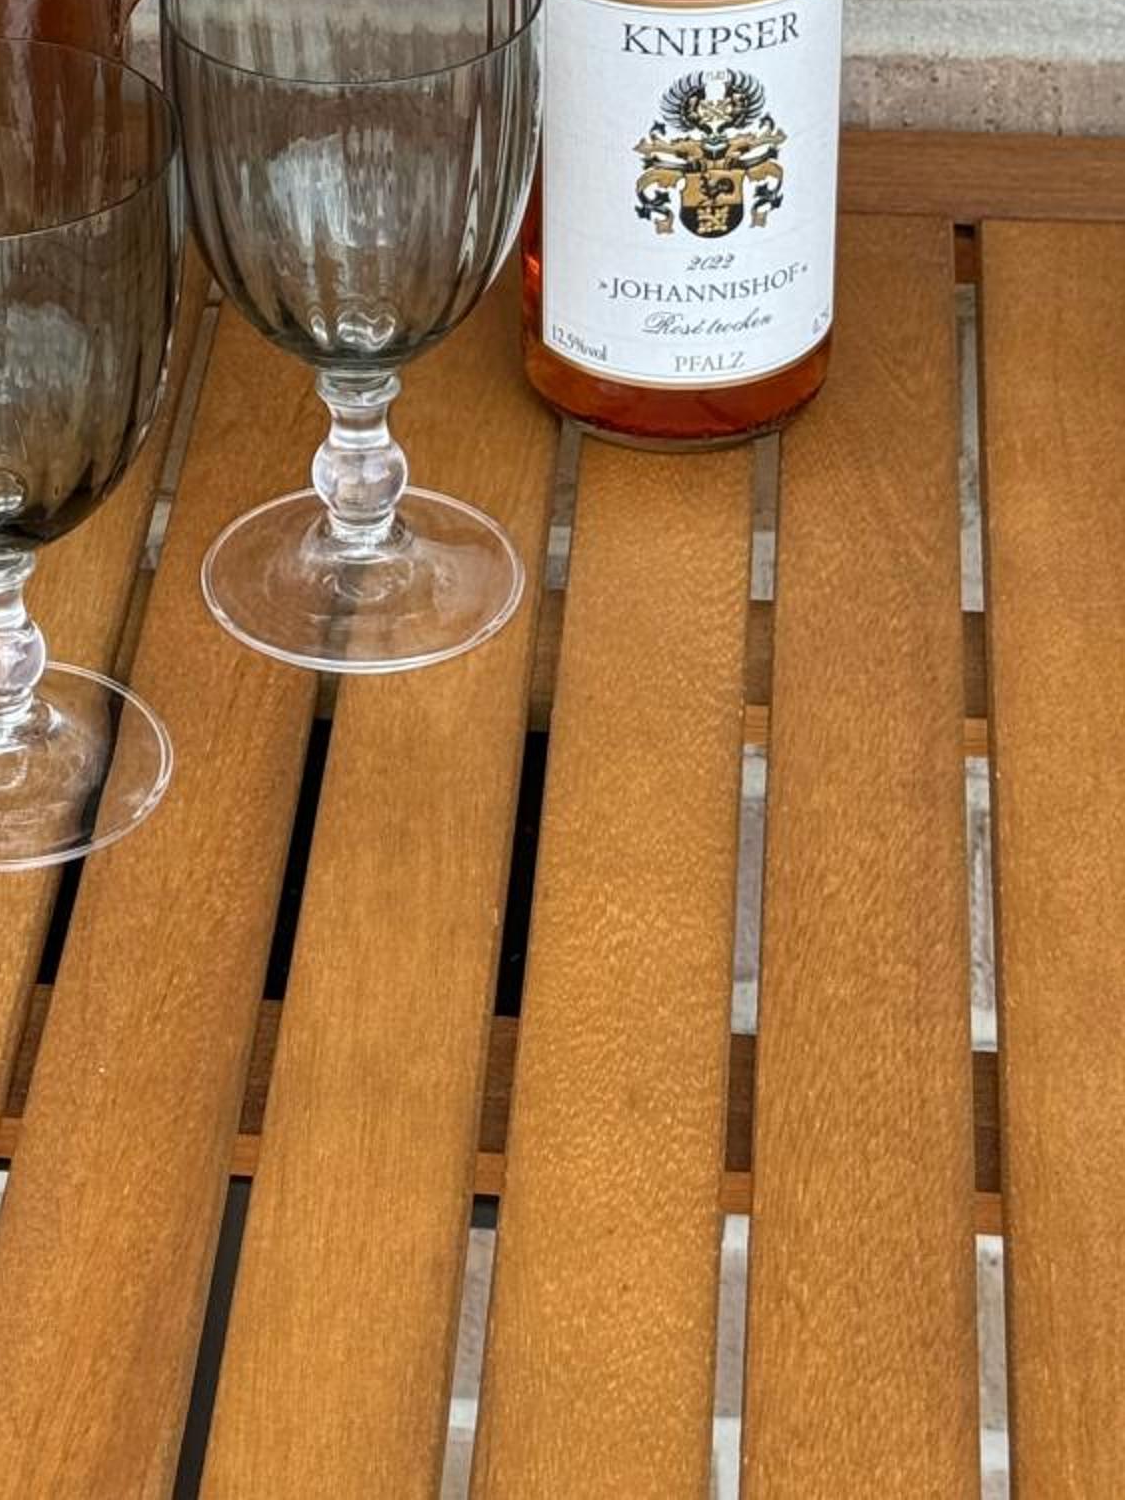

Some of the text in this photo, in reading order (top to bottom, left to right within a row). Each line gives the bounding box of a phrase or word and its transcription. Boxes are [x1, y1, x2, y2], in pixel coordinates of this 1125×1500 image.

[622, 11, 799, 56] KNIPSER
[686, 253, 735, 271] 2022
[675, 351, 745, 373] PFALZ
